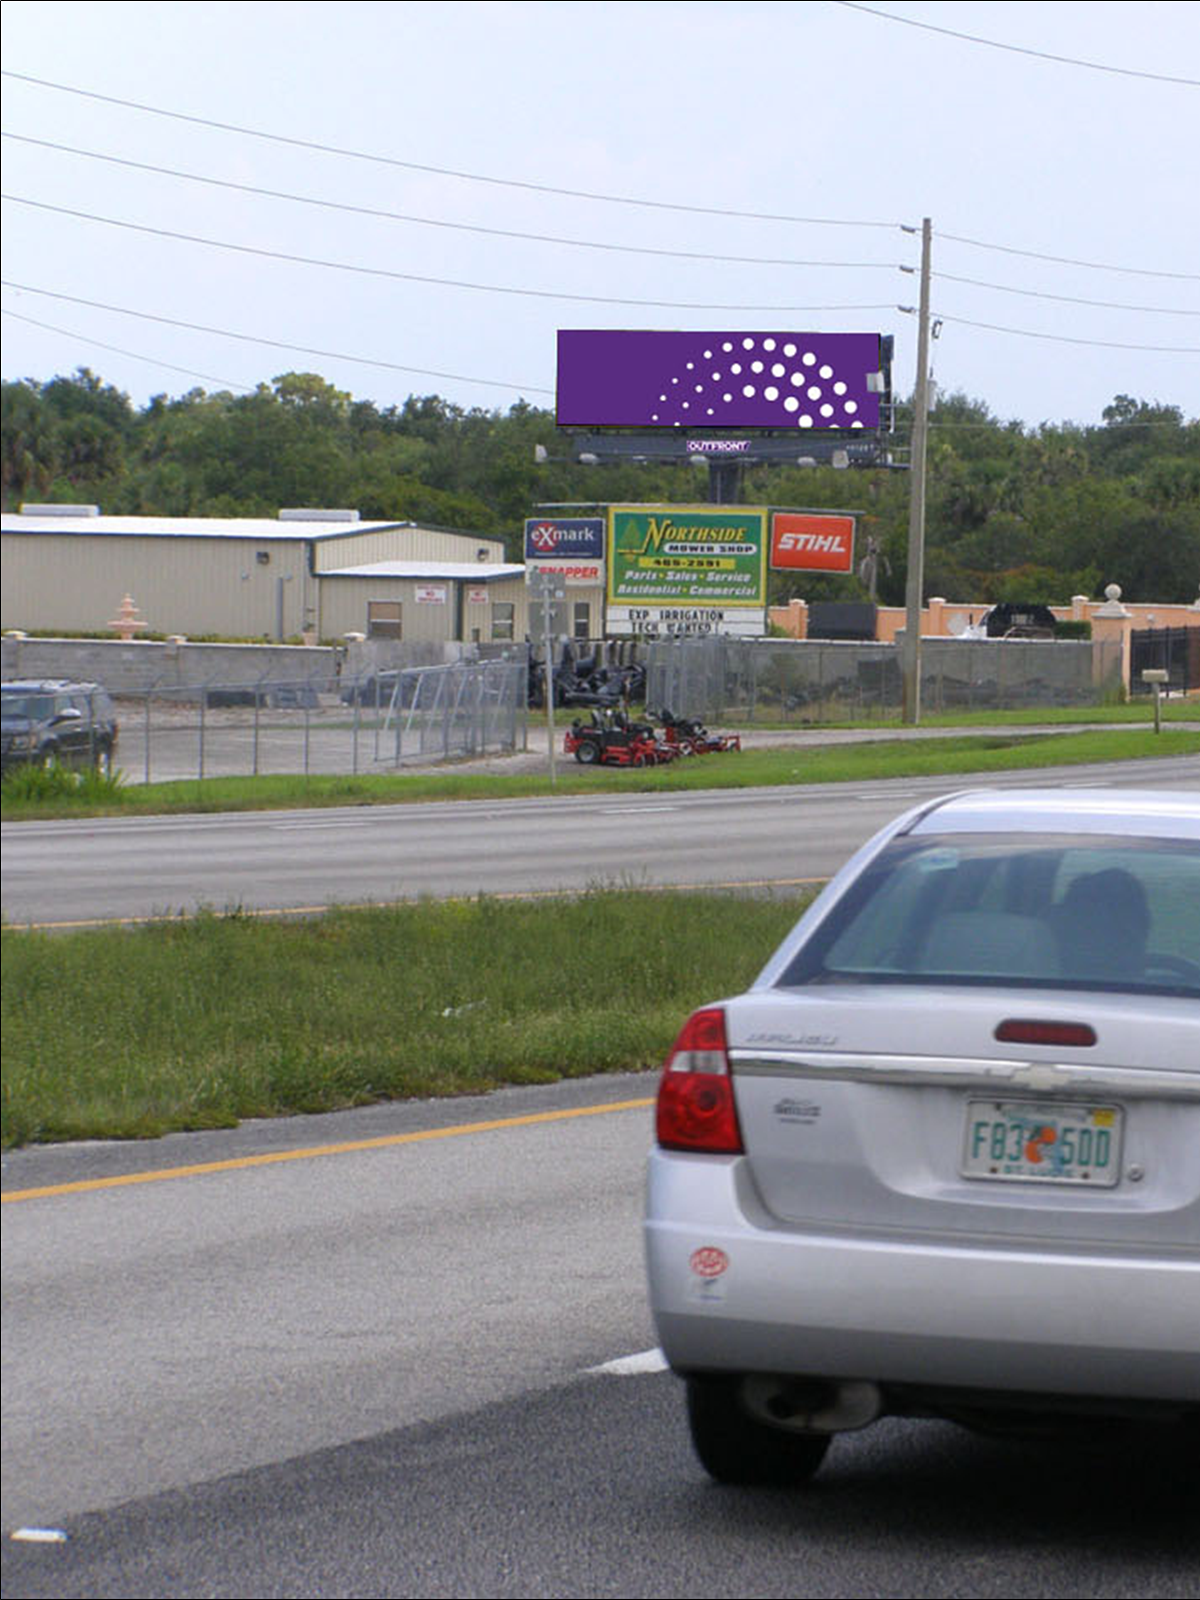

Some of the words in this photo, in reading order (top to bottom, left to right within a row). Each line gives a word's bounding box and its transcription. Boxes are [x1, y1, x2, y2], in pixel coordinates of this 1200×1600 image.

[689, 440, 748, 451] OUTFRONT
[531, 527, 594, 547] eXmark
[778, 533, 846, 552] STIHL
[668, 545, 714, 553] MOWER
[719, 545, 753, 554] SHOP
[538, 565, 599, 579] SNAPPER
[625, 570, 657, 581] Parts
[666, 571, 698, 582] Sales
[706, 572, 751, 583] Service
[618, 584, 684, 595] Residential
[690, 585, 757, 596] Commercial
[629, 609, 650, 621] EXP
[660, 610, 724, 621] IRRIGATION
[631, 622, 659, 633] TECH
[972, 1121, 1023, 1162] F83
